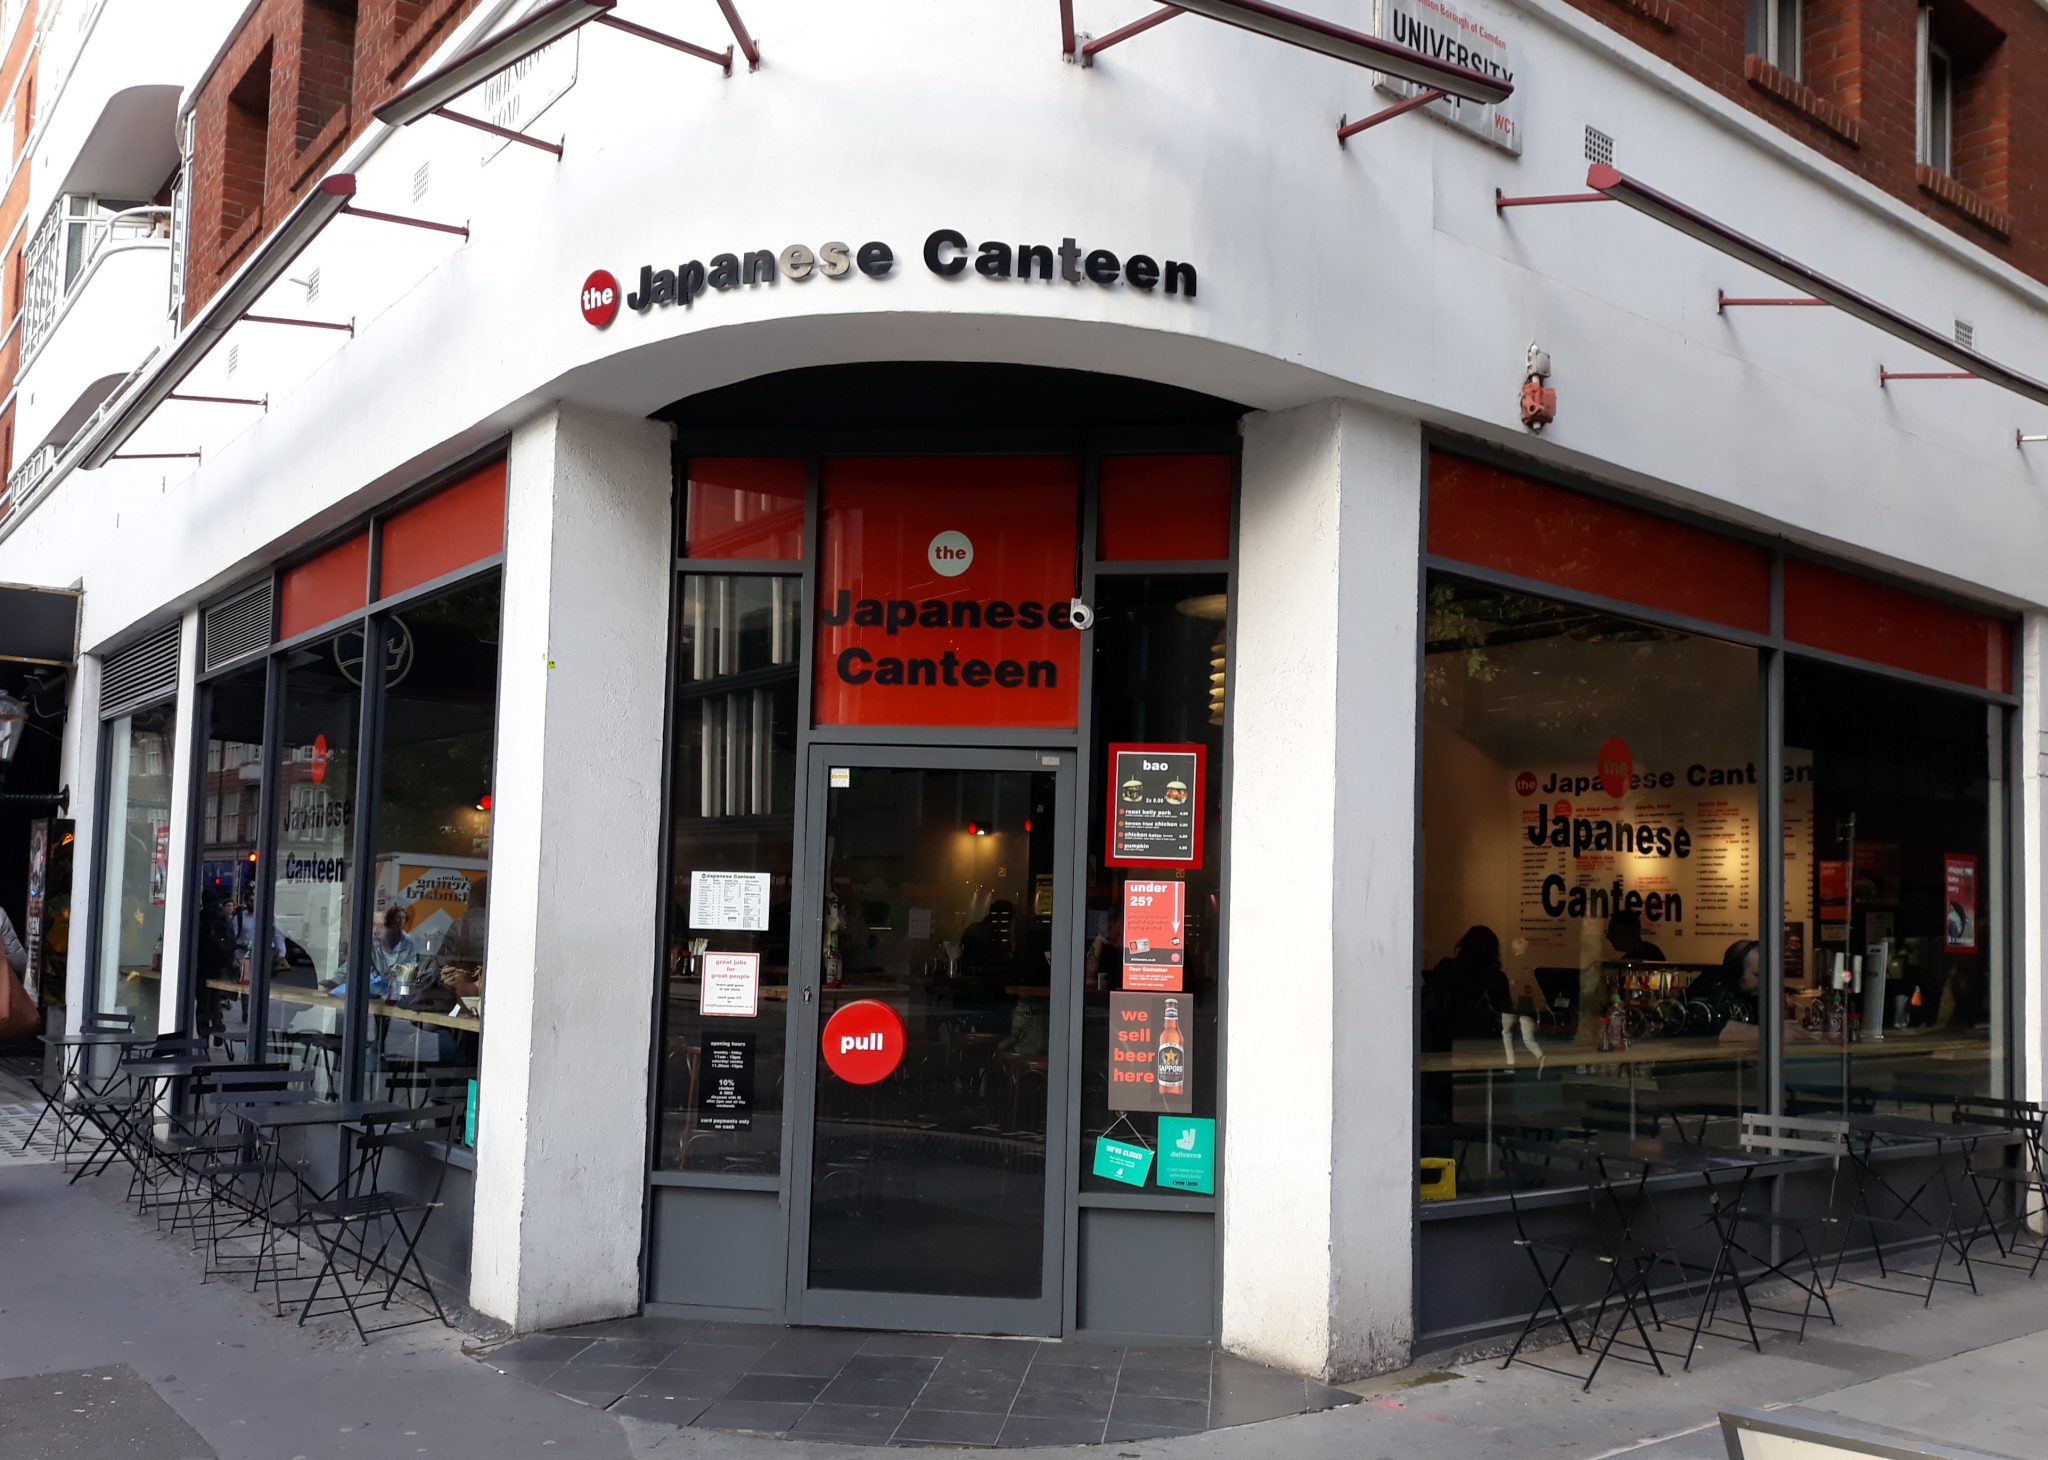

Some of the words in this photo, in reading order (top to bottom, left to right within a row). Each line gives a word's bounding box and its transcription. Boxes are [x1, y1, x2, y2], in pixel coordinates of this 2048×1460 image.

[1418, 0, 1439, 11] ndon
[1440, 4, 1470, 30] Borough
[1471, 24, 1478, 34] of
[1479, 27, 1507, 50] Camden
[1495, 113, 1515, 137] WC1
[583, 286, 613, 312] the
[627, 241, 894, 312] Japanese
[923, 229, 1198, 298] Canteen
[935, 546, 967, 560] the
[821, 589, 1074, 635] Japanese
[837, 647, 1057, 688] Canteen
[1143, 760, 1168, 771] bao
[1516, 775, 1536, 791] the
[1543, 772, 1675, 797] Japaese
[1687, 762, 1813, 787] Canten
[1142, 809, 1156, 817] belly
[1528, 804, 1691, 858] Japanese
[286, 852, 344, 884] Canteen
[1130, 883, 1168, 893] under
[1130, 896, 1153, 907] 25?
[1542, 874, 1682, 922] Canteen
[1121, 1010, 1148, 1022] we
[1118, 1028, 1151, 1042] sell
[841, 1033, 884, 1054] pull
[1114, 1048, 1155, 1062] beer
[1113, 1069, 1155, 1083] here
[1158, 1065, 1183, 1073] SAPPORO
[1171, 1151, 1202, 1159] deliveroo
